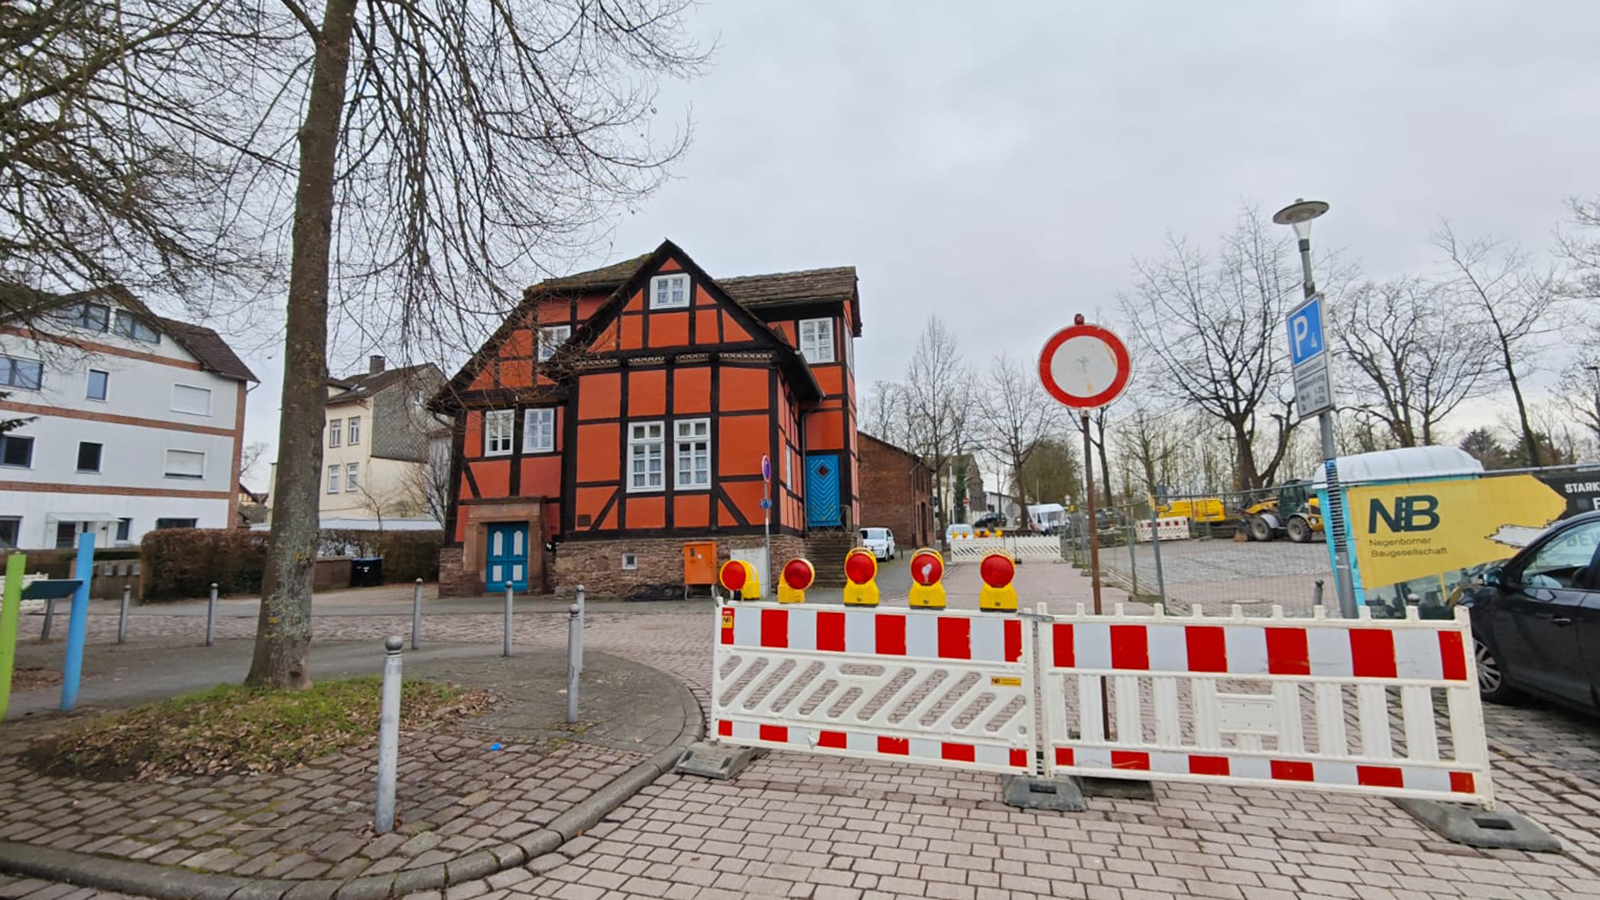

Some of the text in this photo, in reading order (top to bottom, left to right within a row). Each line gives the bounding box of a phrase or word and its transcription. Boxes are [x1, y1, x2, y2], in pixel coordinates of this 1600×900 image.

[1293, 315, 1308, 358] P
[1368, 495, 1441, 534] NB
[1369, 538, 1431, 547] Negenborner
[1371, 547, 1448, 558] Baugesellschaft
